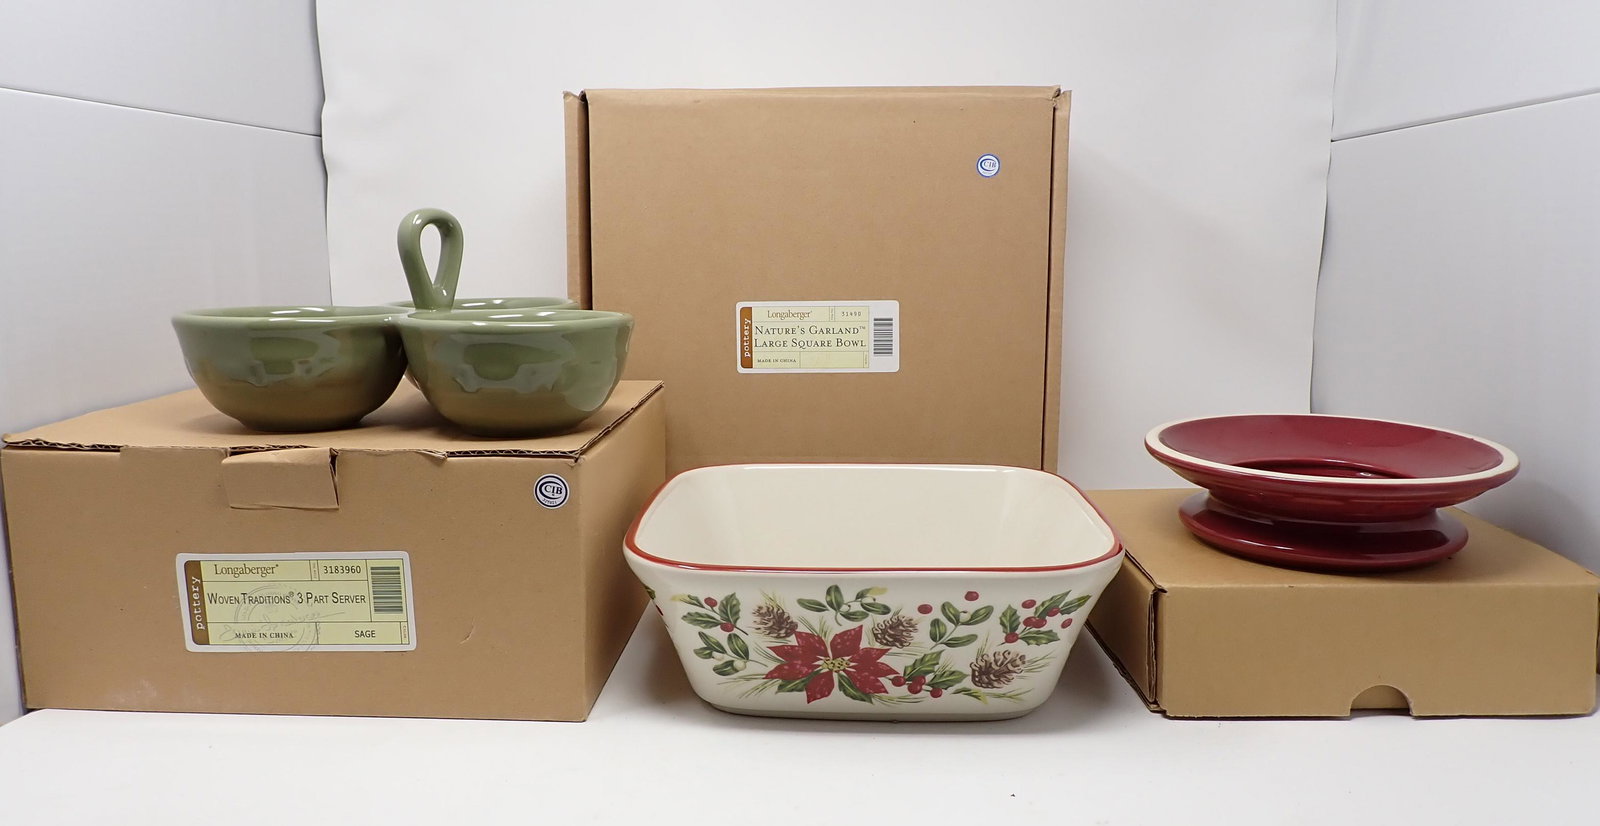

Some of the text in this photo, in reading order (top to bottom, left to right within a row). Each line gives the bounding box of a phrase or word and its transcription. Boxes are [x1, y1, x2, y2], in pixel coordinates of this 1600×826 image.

[755, 325, 806, 335] NATURE'S
[744, 318, 752, 358] pottery
[754, 338, 866, 349] LARGE SQUARE BOWL
[544, 485, 563, 495] CIB
[323, 565, 362, 575] 3183960
[191, 576, 205, 630] pottery
[207, 593, 240, 605] WOVEN
[297, 592, 304, 604] 3
[306, 592, 329, 604] PART
[331, 591, 366, 604] SERVER
[269, 631, 294, 639] CHINA
[354, 630, 376, 638] SAGE
